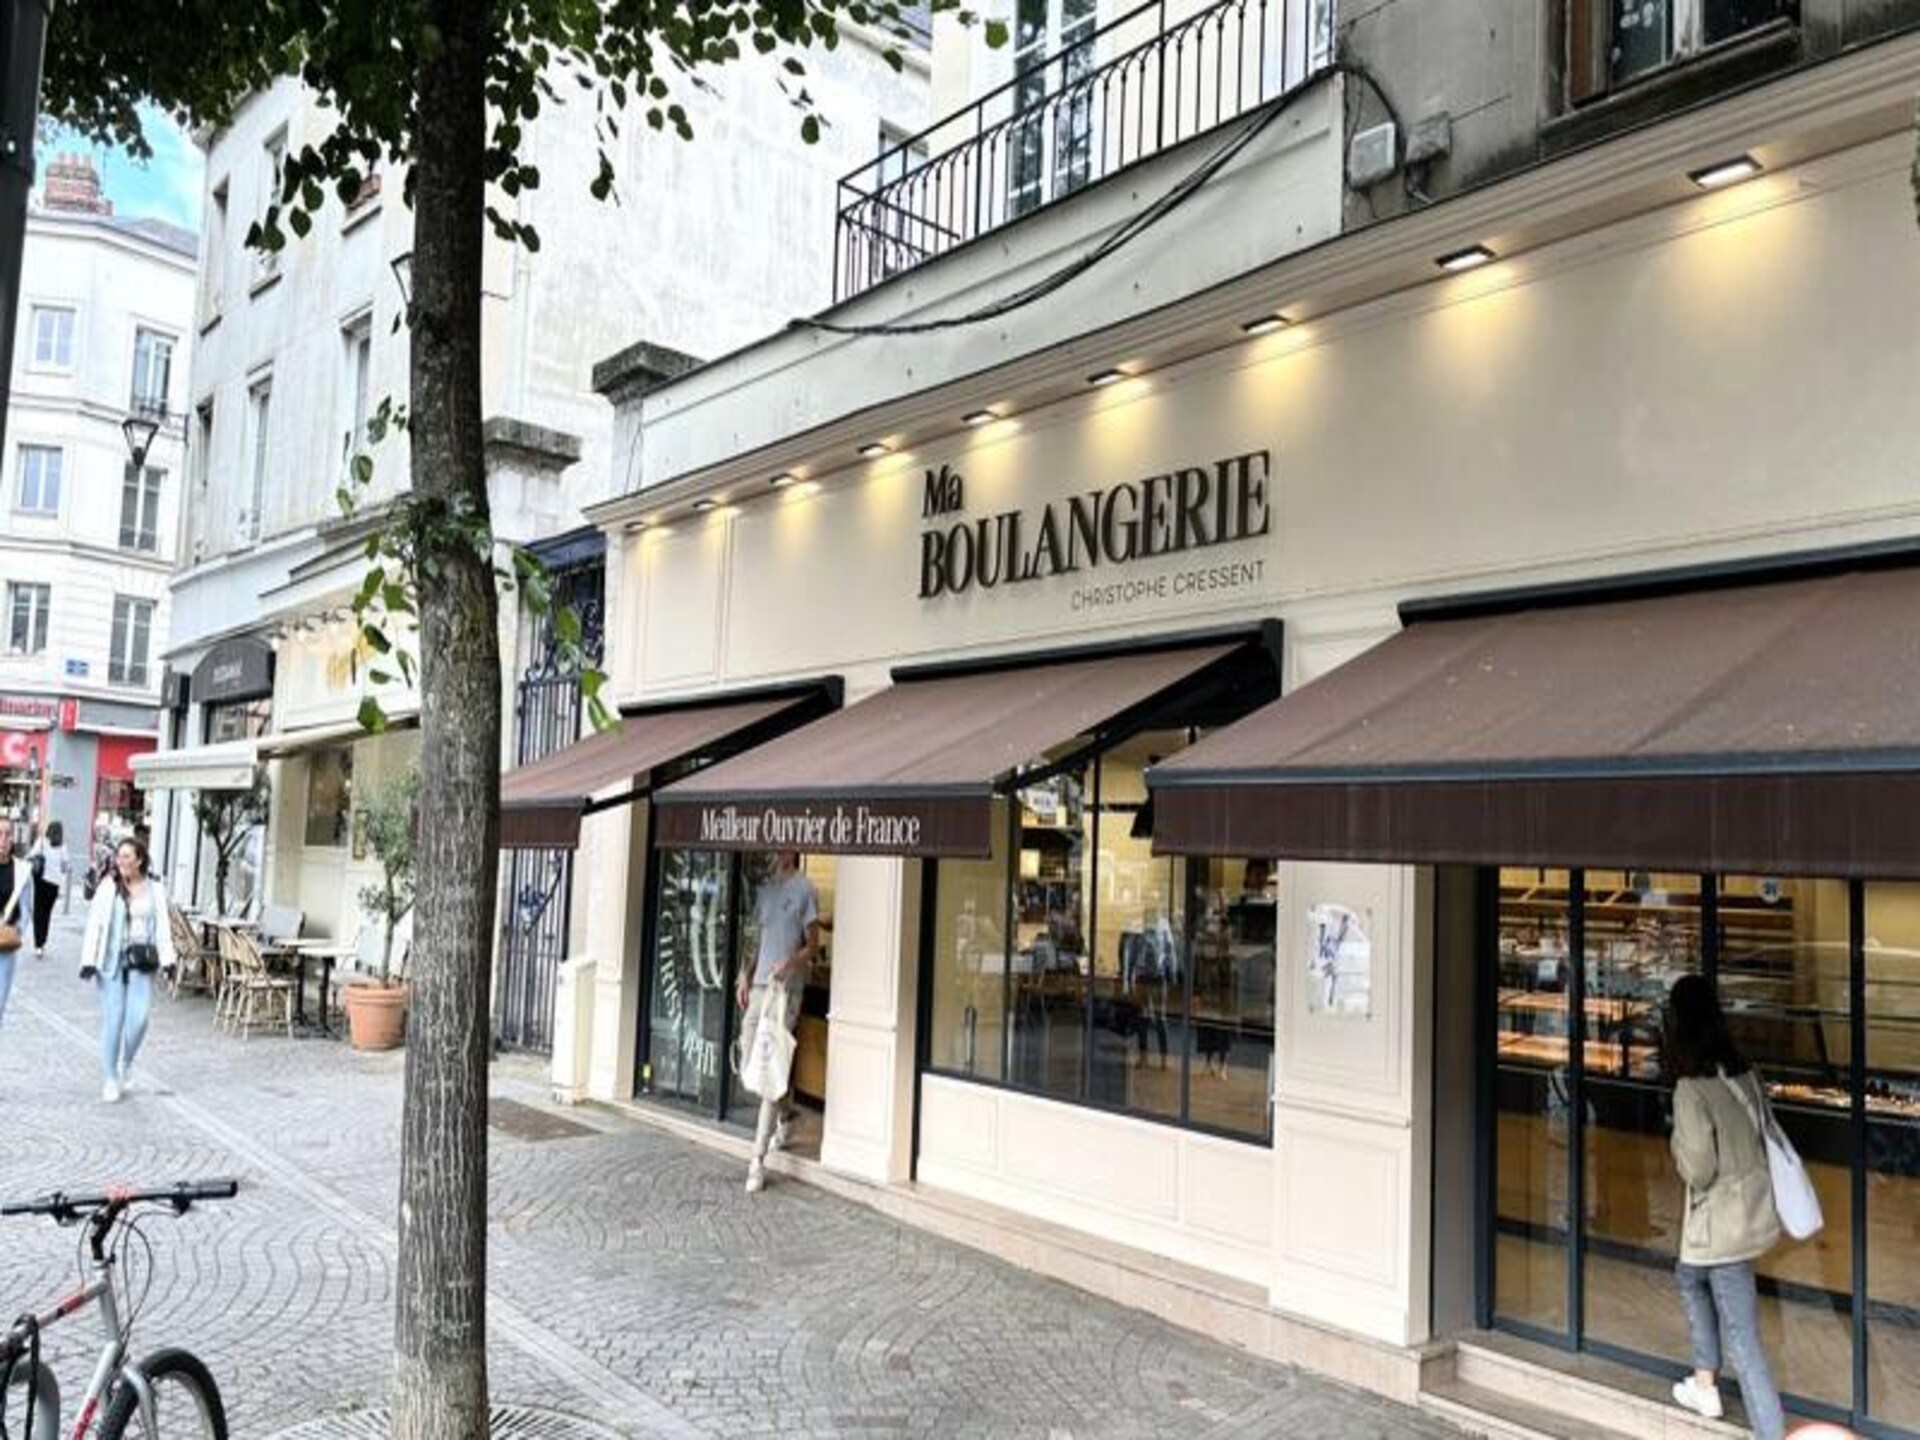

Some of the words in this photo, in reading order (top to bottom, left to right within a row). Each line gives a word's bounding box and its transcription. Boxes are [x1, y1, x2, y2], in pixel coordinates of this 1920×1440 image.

[921, 463, 964, 518] Ma
[917, 449, 1271, 598] BOULANGERIE
[1071, 574, 1166, 611] CHRISTOPHE
[1173, 560, 1266, 596] CRESSENT
[700, 806, 761, 842] Meilleur
[762, 807, 827, 844] Ouvrier
[829, 805, 852, 845] de
[855, 805, 921, 845] France
